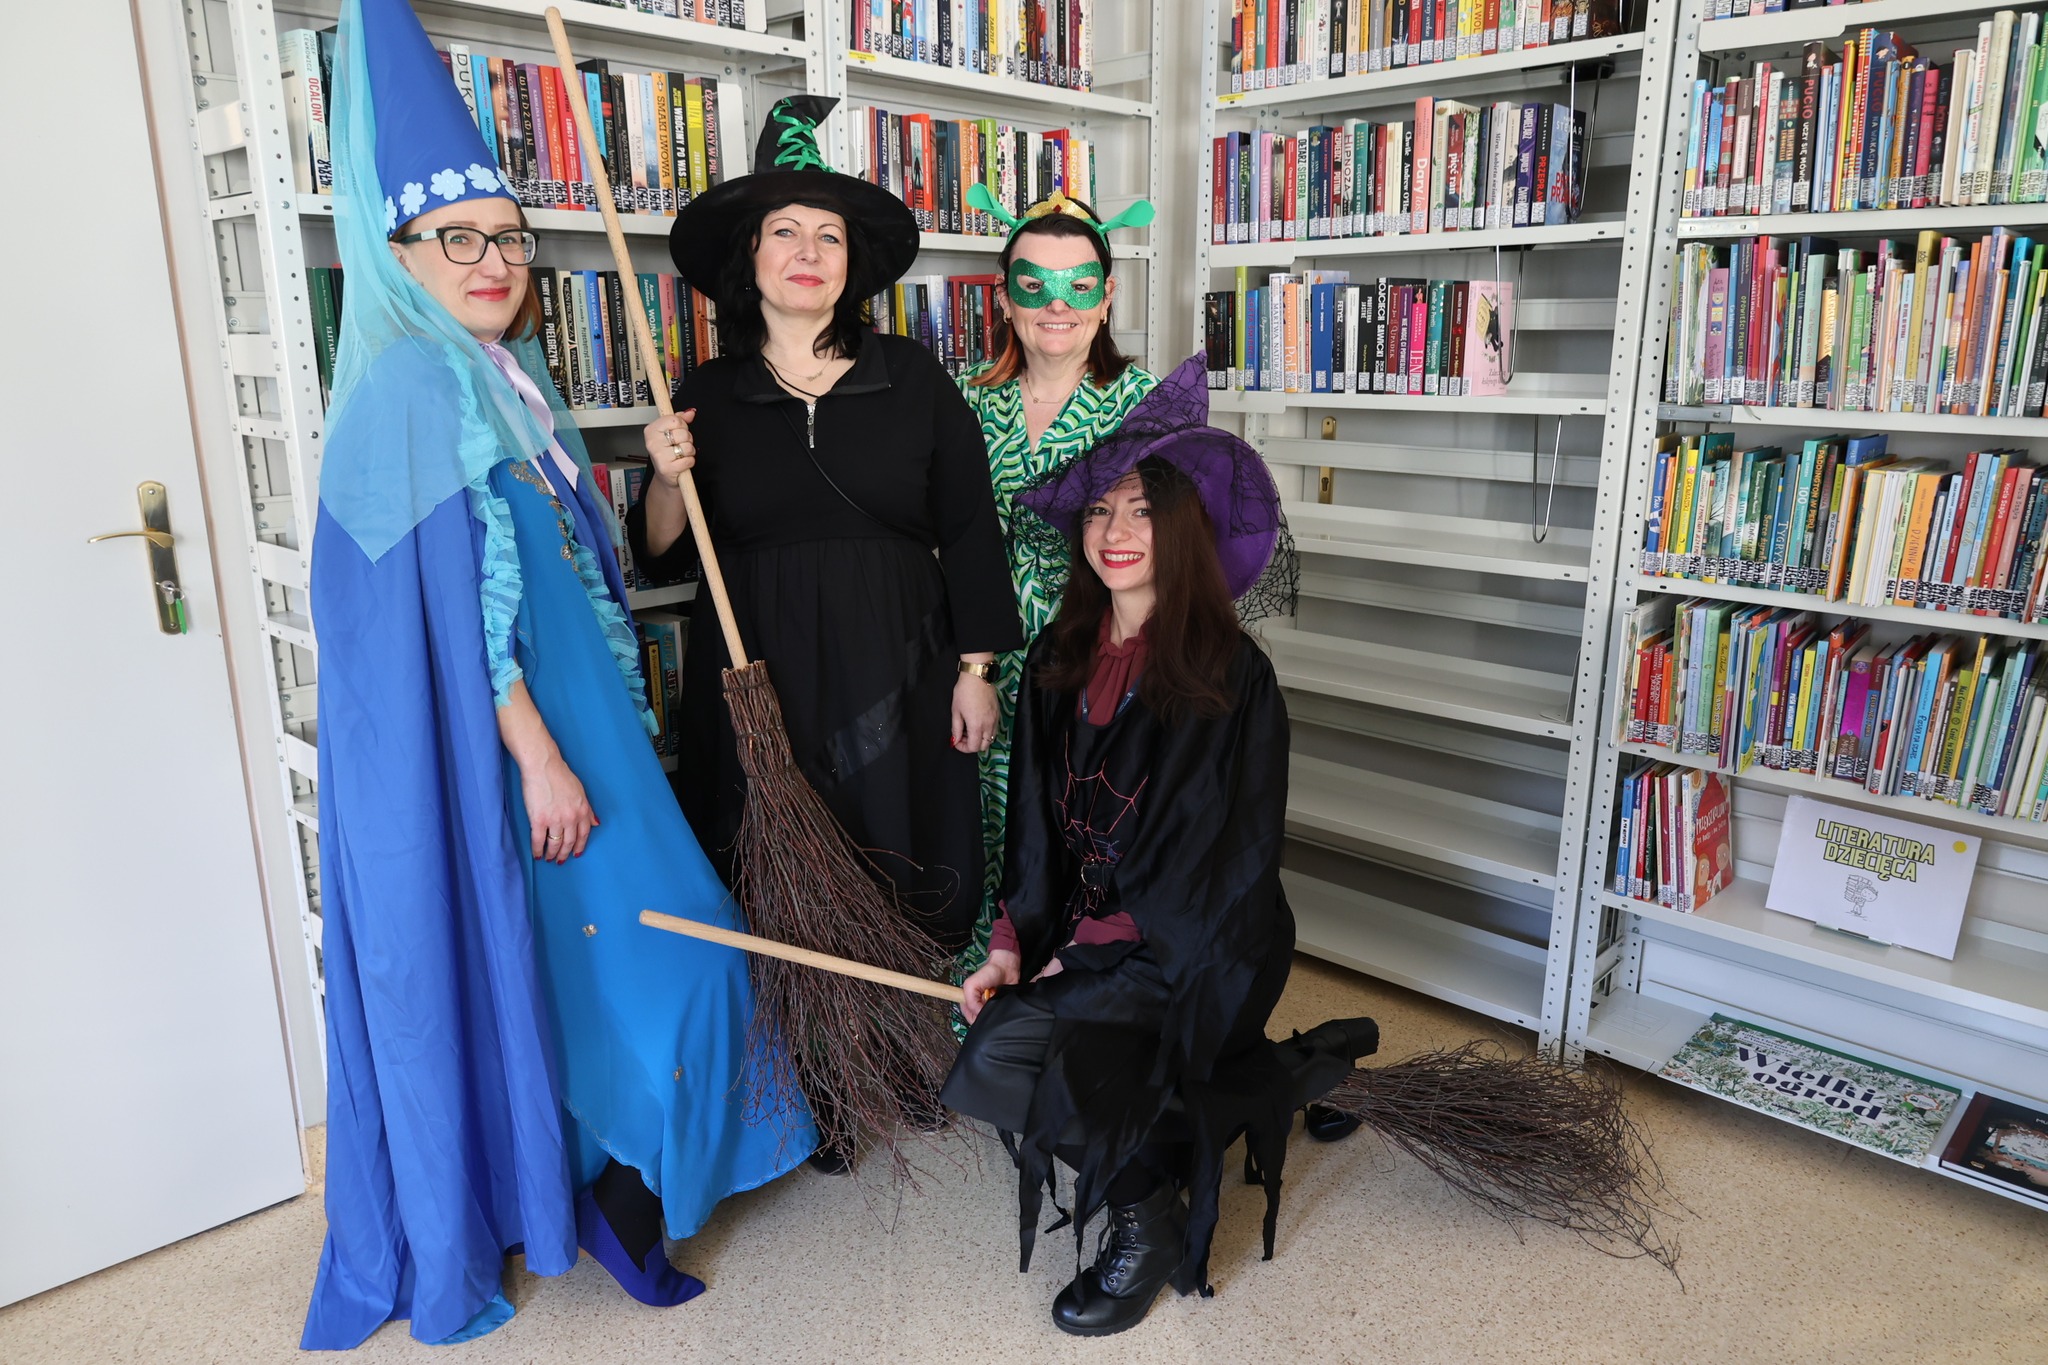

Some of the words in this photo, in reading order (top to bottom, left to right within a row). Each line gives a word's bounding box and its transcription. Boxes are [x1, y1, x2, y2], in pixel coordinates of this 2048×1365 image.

[303, 33, 312, 72] LEWKOWICZ
[1980, 37, 1989, 53] Skąd
[1978, 55, 1987, 65] się
[506, 67, 516, 106] MAŁGORZATA
[1976, 66, 1986, 83] biorą
[308, 76, 323, 123] OCALONY
[532, 88, 541, 117] KAROLINA
[704, 89, 714, 111] CZAS
[1802, 79, 1815, 119] PUCIO
[1871, 70, 1884, 112] PUCIO
[1974, 84, 1984, 104] dziury
[657, 95, 669, 132] SMAKI
[673, 107, 685, 144] WRÓCIMY
[687, 100, 702, 128] BLIZNA
[1522, 107, 1534, 140] CHMIELARZ
[1871, 116, 1881, 128] NA
[565, 118, 574, 138] ŁOWCY
[706, 113, 716, 146] WOLNY
[568, 139, 576, 155] SKÓR
[621, 129, 630, 174] KRÓLEWSKA
[659, 134, 670, 178] LWOWA
[676, 147, 685, 158] PO
[707, 147, 716, 158] W
[1298, 138, 1307, 164] OŁTARZ
[1404, 131, 1412, 156] Chwile
[1786, 128, 1796, 161] BIBLIOTEKA
[1799, 142, 1808, 156] SIĘ
[1867, 130, 1879, 176] WAKACJACH
[677, 159, 687, 177] WAS
[708, 159, 717, 175] PRL
[1344, 134, 1353, 192] HIPNOZA
[1413, 157, 1428, 193] Dary
[1448, 152, 1458, 174] pięć
[1297, 166, 1306, 200] SIEKIERA
[1333, 171, 1341, 195] PUTINA
[1449, 175, 1457, 195] ran
[1536, 155, 1547, 203] PRZEPRAW
[554, 181, 567, 204] 147912
[569, 182, 583, 205] 147913
[649, 189, 662, 211] 147951
[1415, 195, 1425, 210] los
[540, 277, 550, 296] TERRY
[643, 278, 651, 307] Jacobsen
[1377, 277, 1386, 321] WOJCIECH
[543, 297, 553, 316] HAYES
[591, 304, 599, 330] GORNICK
[615, 301, 624, 335] RAEDISCH
[1336, 300, 1344, 324] FETYSZ
[1729, 304, 1735, 313] Co
[1739, 295, 1747, 330] OPOWIEŚCI
[566, 302, 575, 338] PROROCZA
[647, 308, 657, 337] WOJNA
[920, 311, 929, 336] DZIECI
[1727, 313, 1735, 327] lubią
[325, 326, 335, 362] ELITARNE
[545, 322, 559, 366] PIELGRZYM
[668, 315, 676, 352] Wspomnienia
[710, 326, 718, 359] MILIONÓW
[1377, 324, 1385, 358] SAWICKI
[1389, 325, 1398, 359] UPADEK
[1737, 331, 1745, 350] PEŁNE
[571, 350, 579, 367] PAUL
[1430, 340, 1438, 369] Nieznajoma
[584, 358, 592, 379] historię
[1803, 461, 1811, 477] GREEN
[1811, 449, 1824, 498] PADDINGTON
[1973, 471, 1986, 489] Emilia
[1683, 477, 1693, 511] OPOWIASTKI
[1797, 486, 1809, 504] 100
[1809, 499, 1817, 508] W
[1969, 490, 1982, 508] Kiereś
[2001, 482, 2012, 500] Kocia
[2015, 483, 2026, 500] Kocia
[617, 503, 625, 520] PRL
[1738, 496, 1747, 514] RADA
[1997, 499, 2009, 520] Szajka
[2011, 501, 2023, 520] Szajka
[2021, 493, 2036, 532] Laboratorium
[1734, 515, 1744, 545] SMOKÓW
[1761, 513, 1772, 536] Serce
[1807, 508, 1816, 529] PERU
[1757, 537, 1768, 563] żyrafy
[1772, 520, 1788, 564] TYGRYS
[1907, 529, 1922, 565] DZIENNIK
[1704, 558, 1716, 578] 147389
[1654, 673, 1663, 704] MAGICZNE
[1959, 685, 1968, 695] Max
[1940, 748, 1954, 775] SKŁODOWSK
[1815, 818, 1935, 865] LITERATURA
[1823, 841, 1916, 882] DZIECIĘCA
[1738, 1046, 1877, 1103] Wielki
